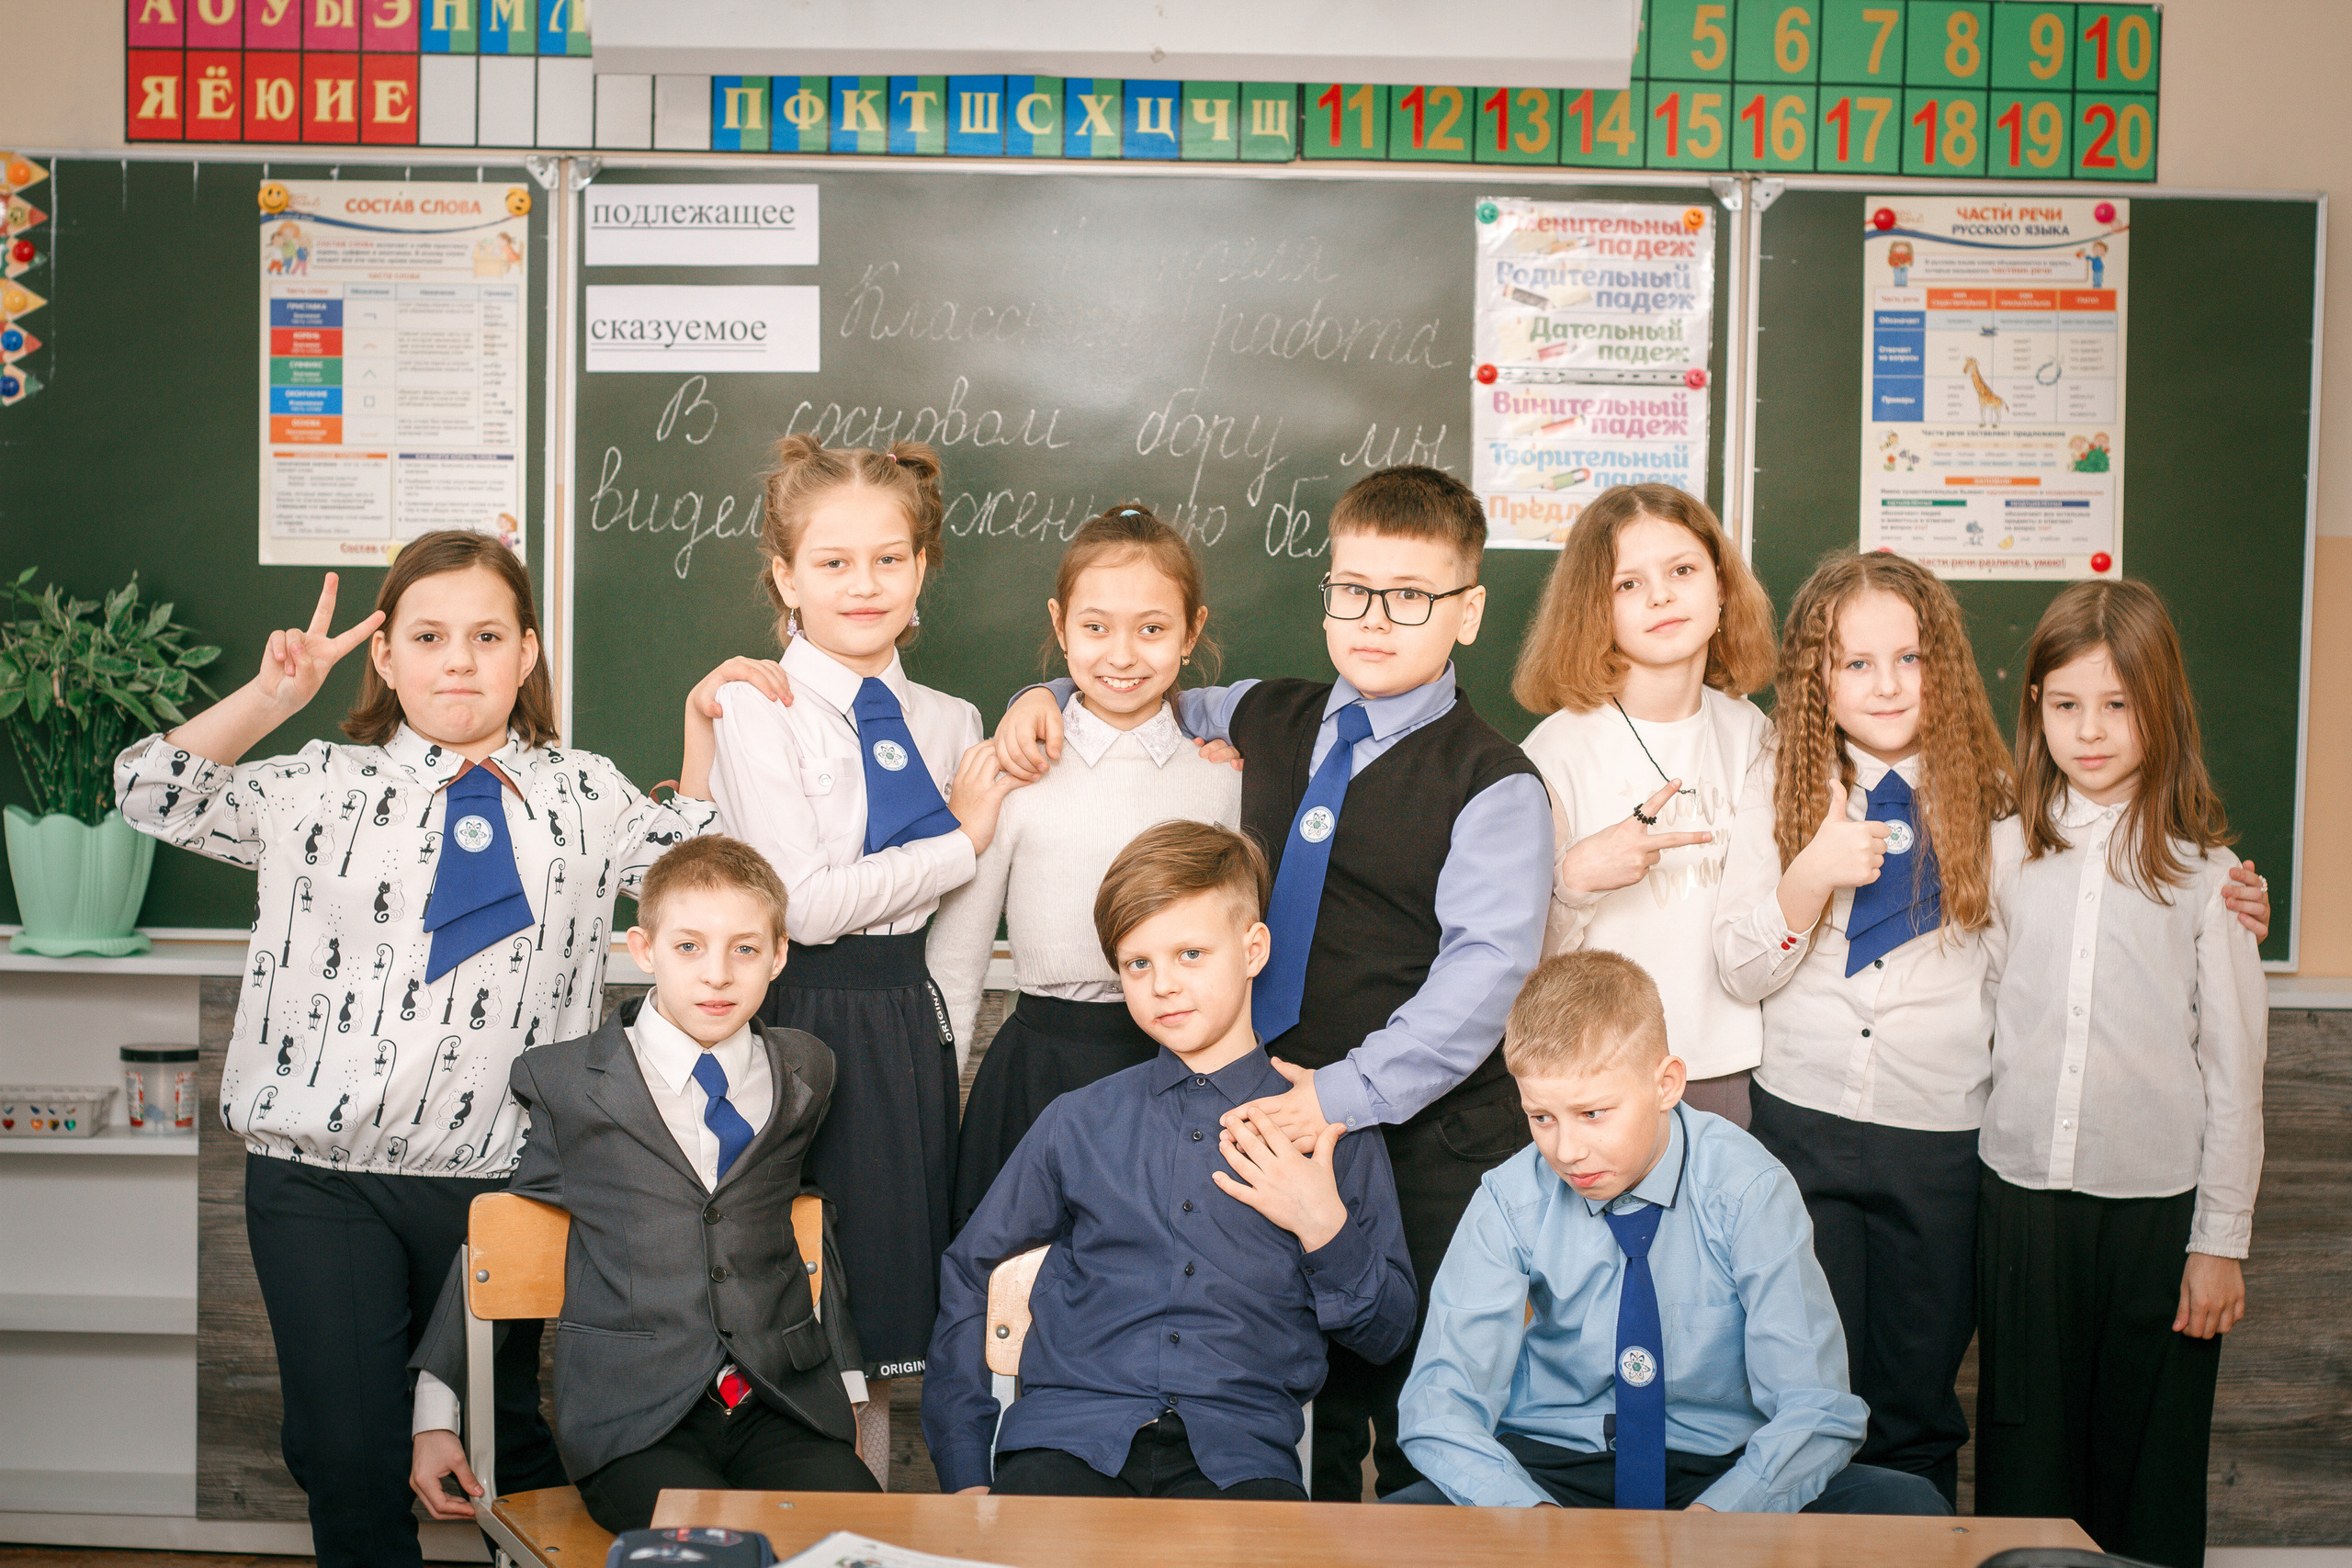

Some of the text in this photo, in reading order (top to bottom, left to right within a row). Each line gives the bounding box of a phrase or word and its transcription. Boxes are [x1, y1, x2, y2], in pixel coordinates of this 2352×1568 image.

[1691, 5, 2153, 82] 5 6 7 8 9 10
[137, 66, 412, 123] Я Ё Ю И Е
[722, 87, 1290, 144] П Ф К Т Ш С Х Ц Ч Щ
[1317, 84, 2153, 171] 11 12 13 14 15 16 17 18 19 20
[345, 198, 482, 215] СОСТАВ СЛОВА
[592, 201, 796, 231] подлежащее
[1957, 207, 2064, 221] ЧАСТИ РЕЧИ
[1497, 210, 1700, 236] енительны
[1951, 224, 2071, 236] РУССКОГО ЯЗЫКА
[1597, 238, 1696, 261] падеж
[1496, 261, 1692, 290] Родительный
[1595, 290, 1696, 314] падеж
[591, 318, 768, 348] сказуемое
[1529, 316, 1684, 344] Дательный
[1193, 299, 1453, 411] работа
[1597, 343, 1690, 366] падеж
[1492, 391, 1690, 417] Винительный
[655, 375, 1455, 508] В сосновом бору мы
[1590, 416, 1689, 439] падеж
[1488, 442, 1690, 472] Творительный
[879, 1359, 927, 1377] ORIGIN
